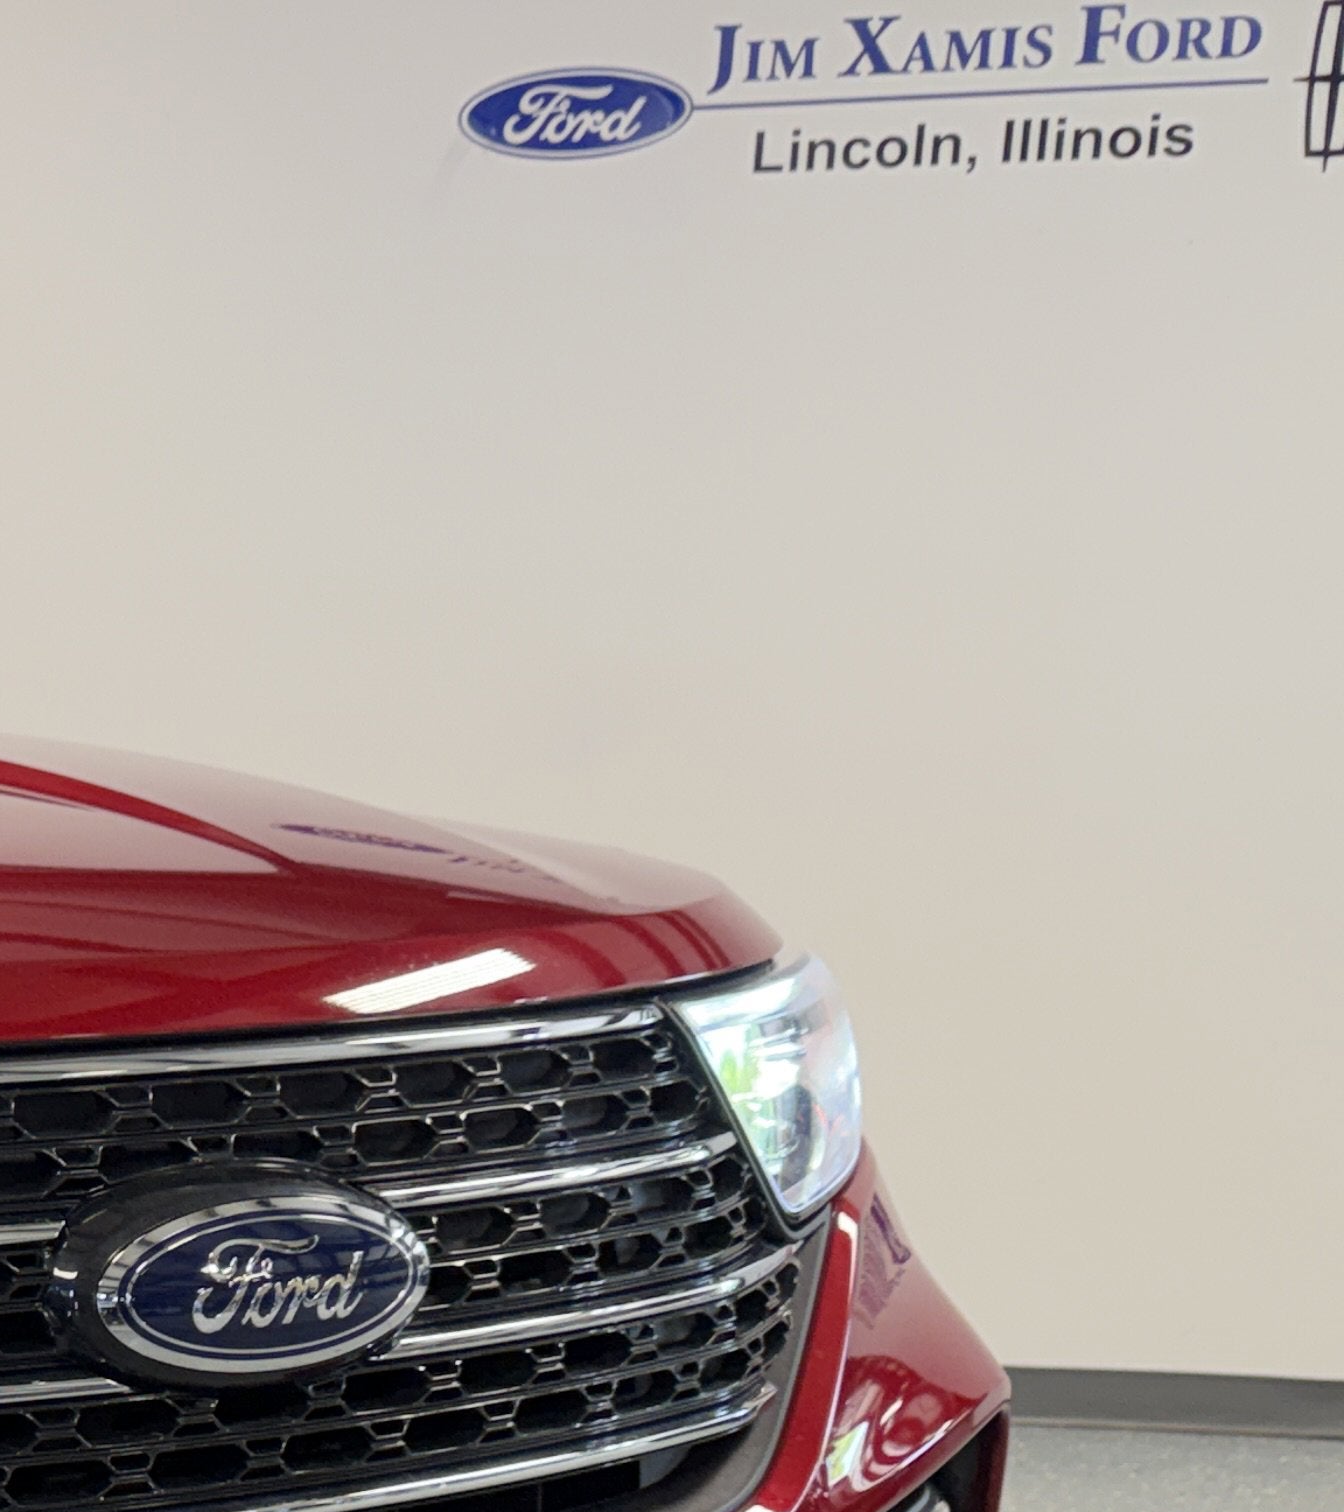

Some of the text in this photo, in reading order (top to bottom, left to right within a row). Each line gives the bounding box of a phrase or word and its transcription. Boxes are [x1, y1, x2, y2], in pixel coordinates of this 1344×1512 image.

[707, 3, 1262, 95] JIM XAMIS FORD
[502, 83, 648, 145] Ford
[752, 112, 1194, 174] Lincoln, Illinois
[191, 1233, 365, 1335] Ford
